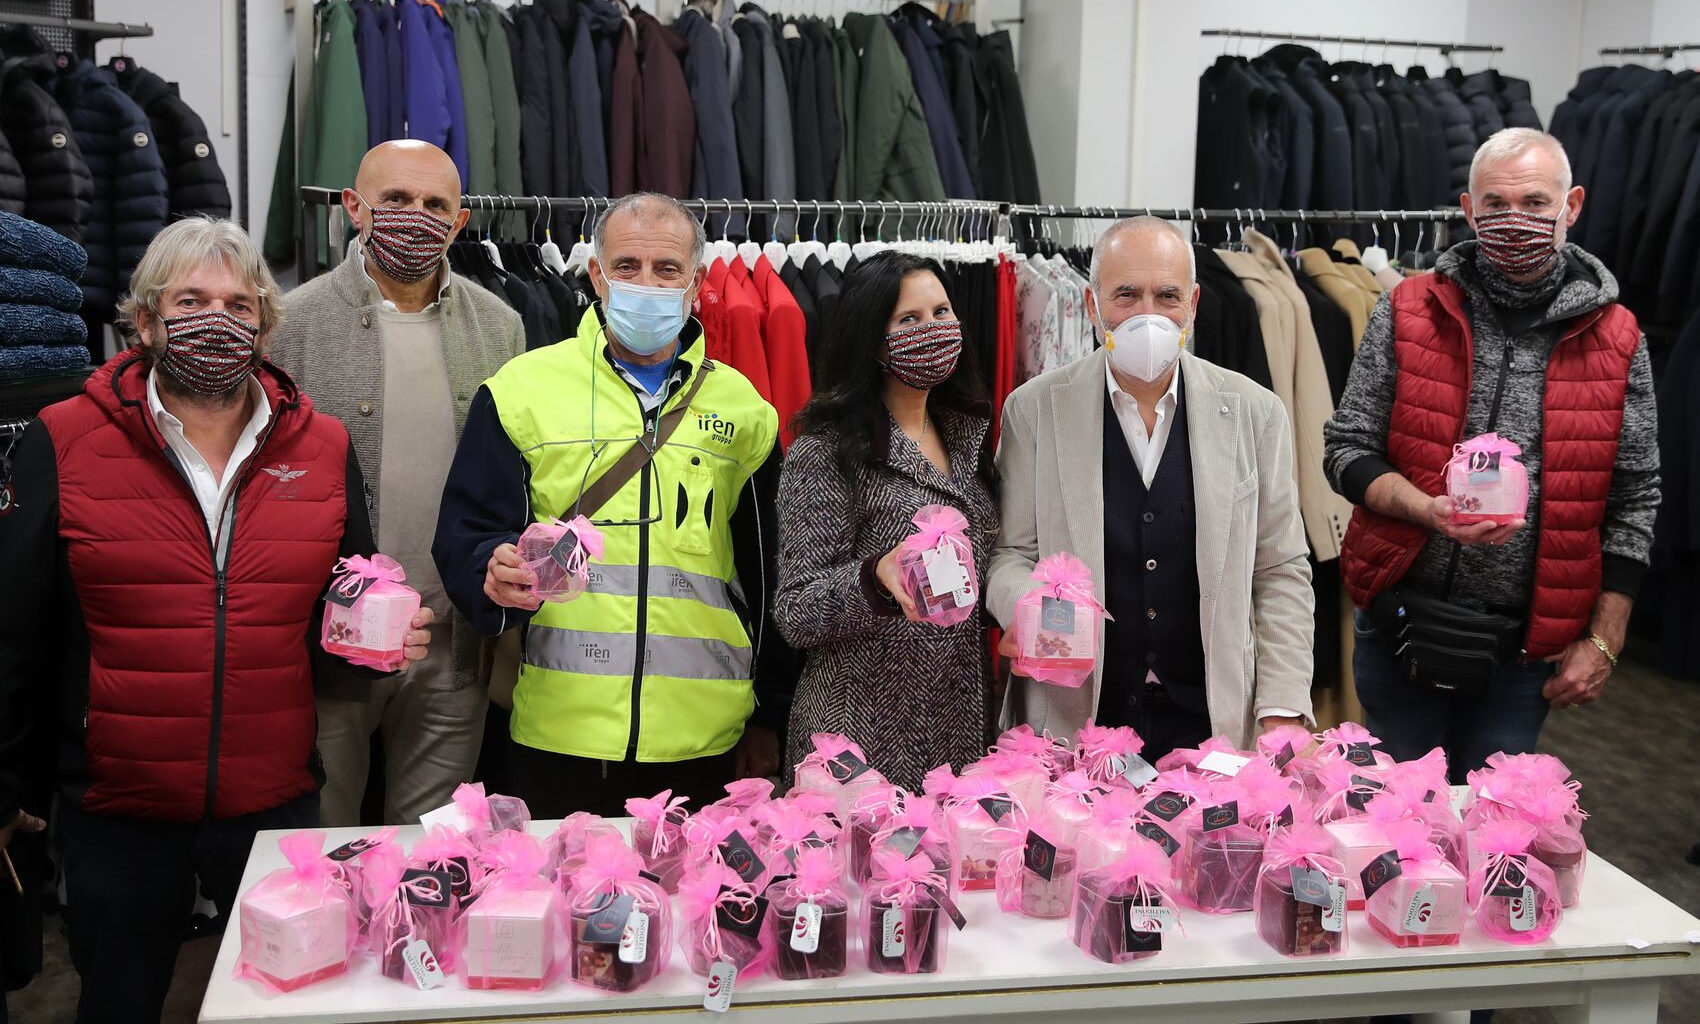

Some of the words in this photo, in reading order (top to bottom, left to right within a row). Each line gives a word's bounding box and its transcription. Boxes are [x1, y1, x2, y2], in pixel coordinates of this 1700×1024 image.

[698, 414, 735, 438] iren
[711, 433, 732, 444] gruppo
[585, 646, 610, 658] iren
[1336, 890, 1344, 929] VALTIDONE
[1404, 890, 1421, 927] VALTIDONE
[1526, 890, 1534, 927] VALTIDONE
[637, 917, 646, 959] VALTIDONE
[404, 949, 426, 986] VALTIDONE
[720, 969, 735, 1009] VALTIDONE
